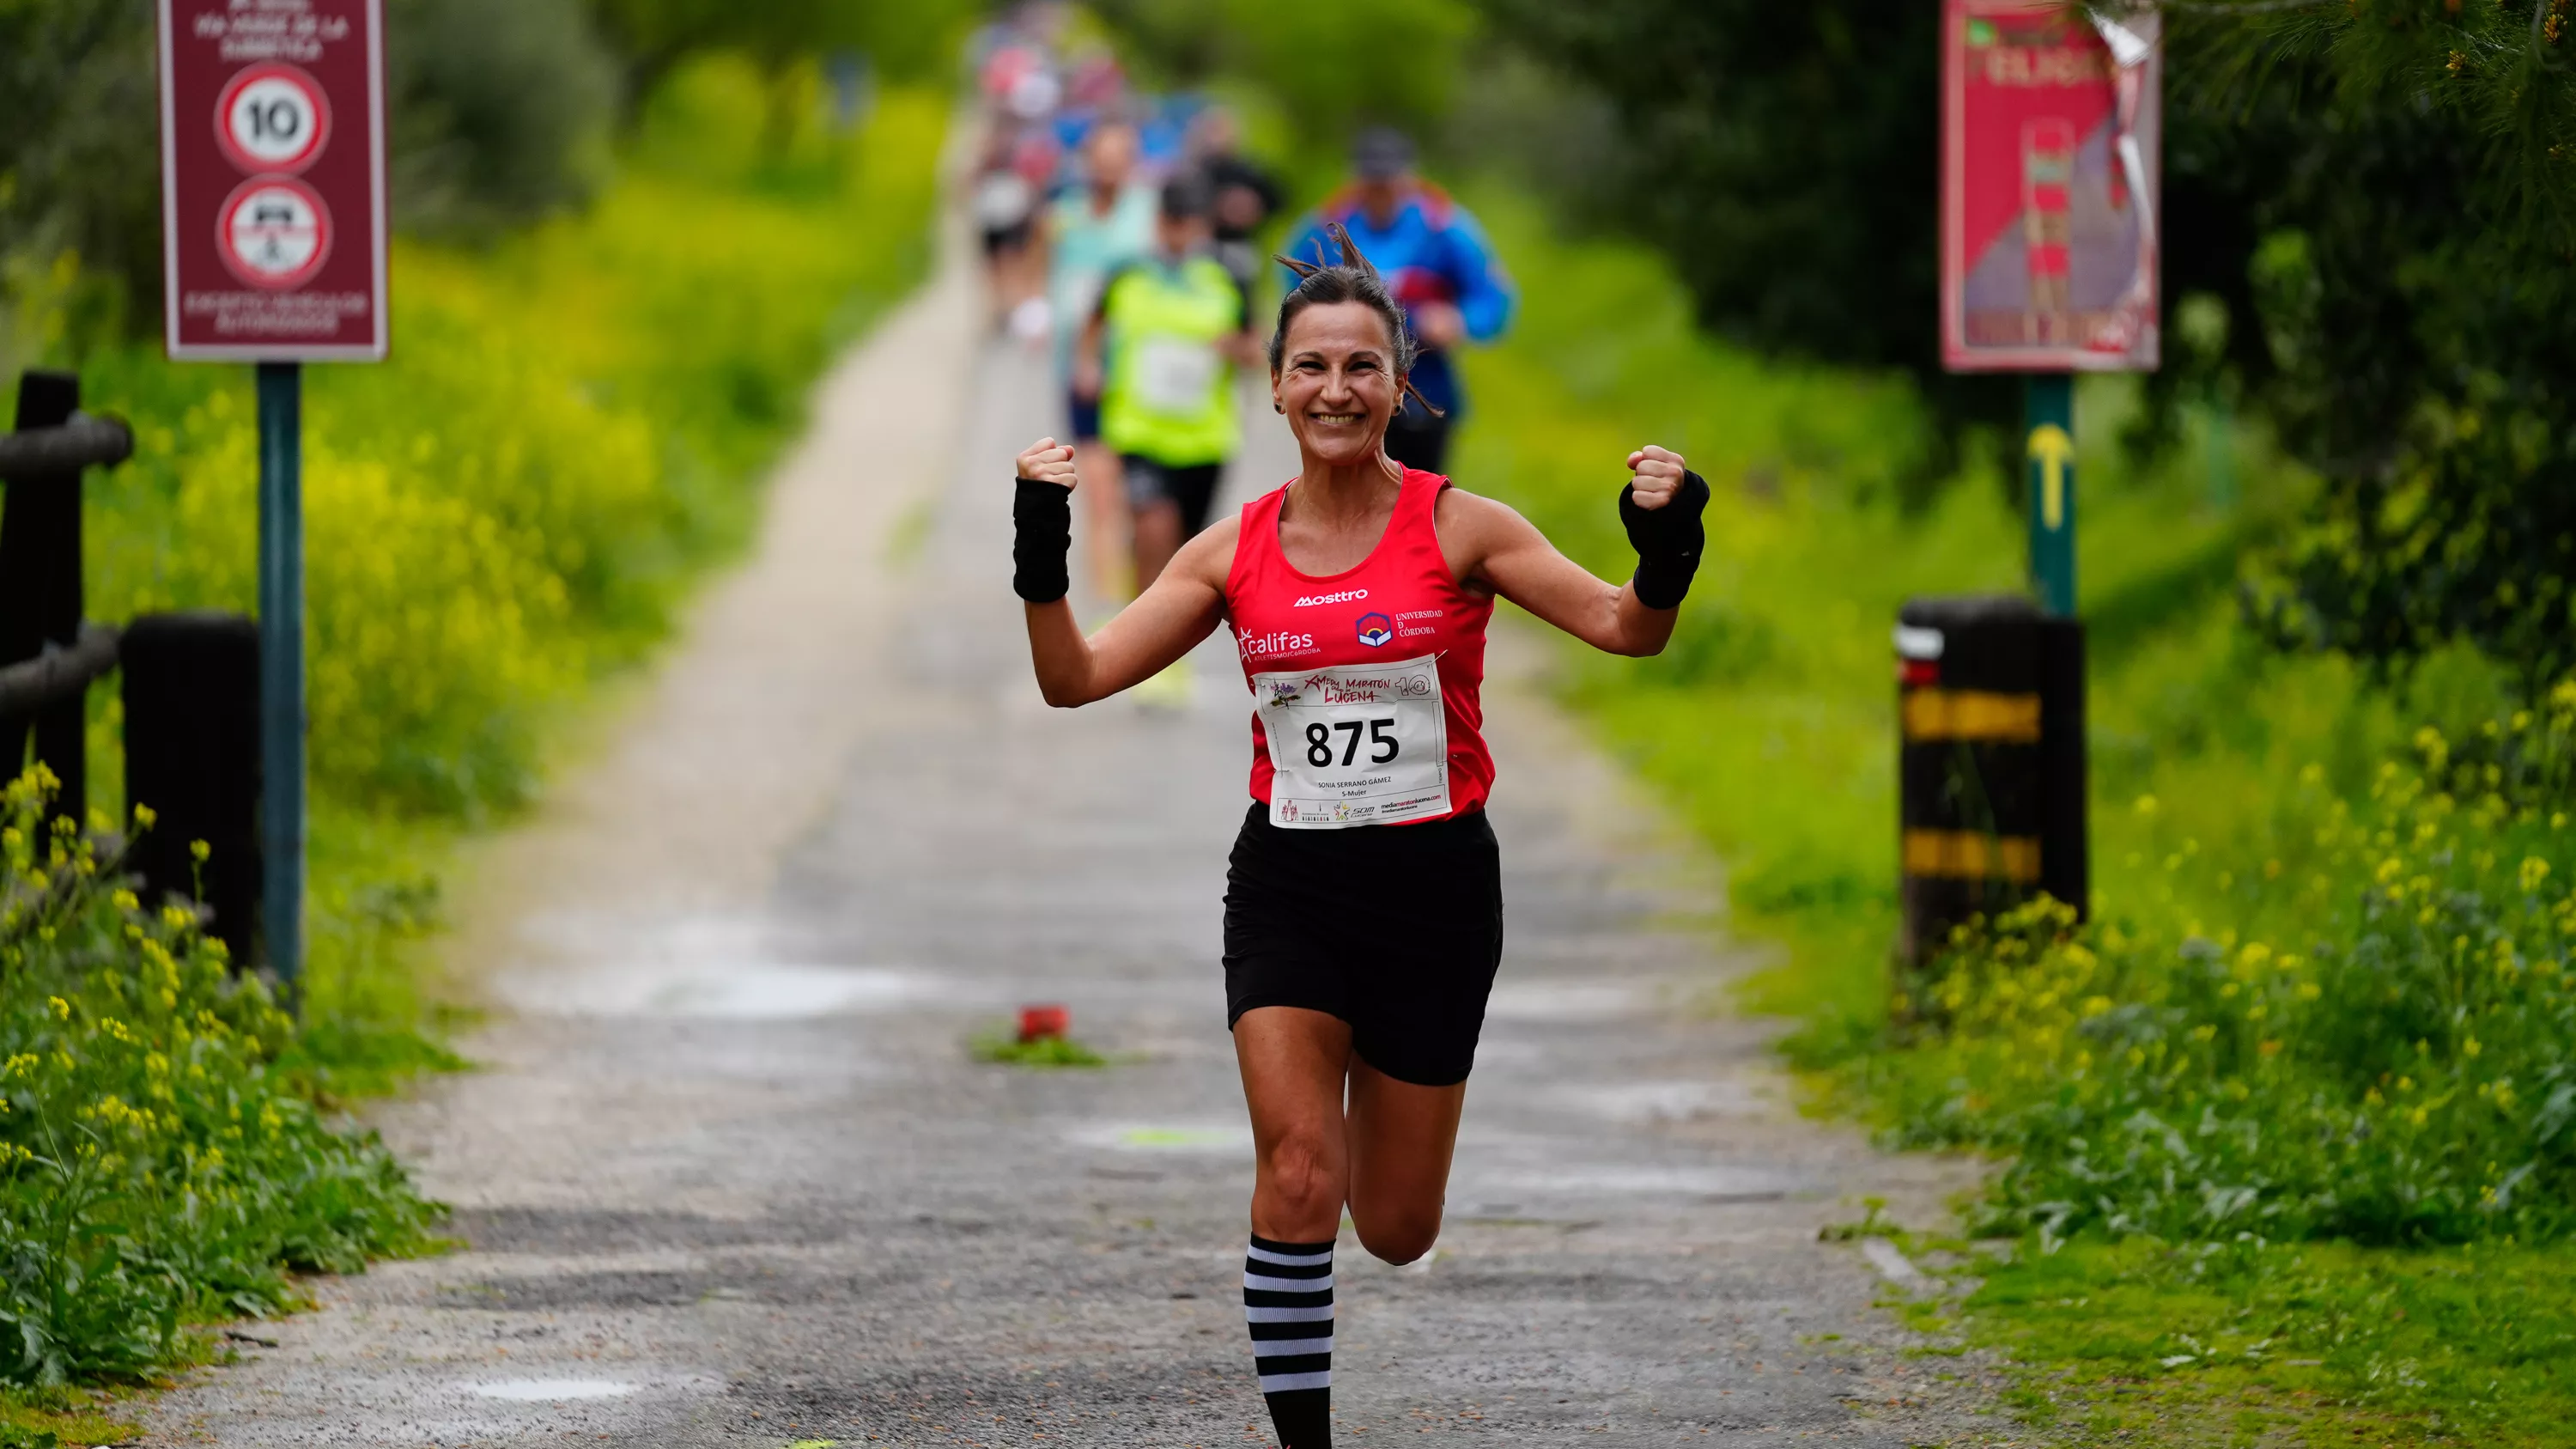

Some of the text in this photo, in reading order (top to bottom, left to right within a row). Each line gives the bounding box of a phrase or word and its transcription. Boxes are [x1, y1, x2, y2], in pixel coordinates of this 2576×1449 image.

[250, 98, 299, 141] 10
[1395, 610, 1443, 621] UNIVERSIDAD
[1399, 626, 1435, 637] CÓRDOBA
[1248, 631, 1313, 654] califas
[1325, 687, 1381, 703] LUCENA
[1306, 718, 1400, 767] 875
[1368, 776, 1392, 785] GÁMEZ
[1381, 795, 1442, 809] mediamaratonlucena.com
